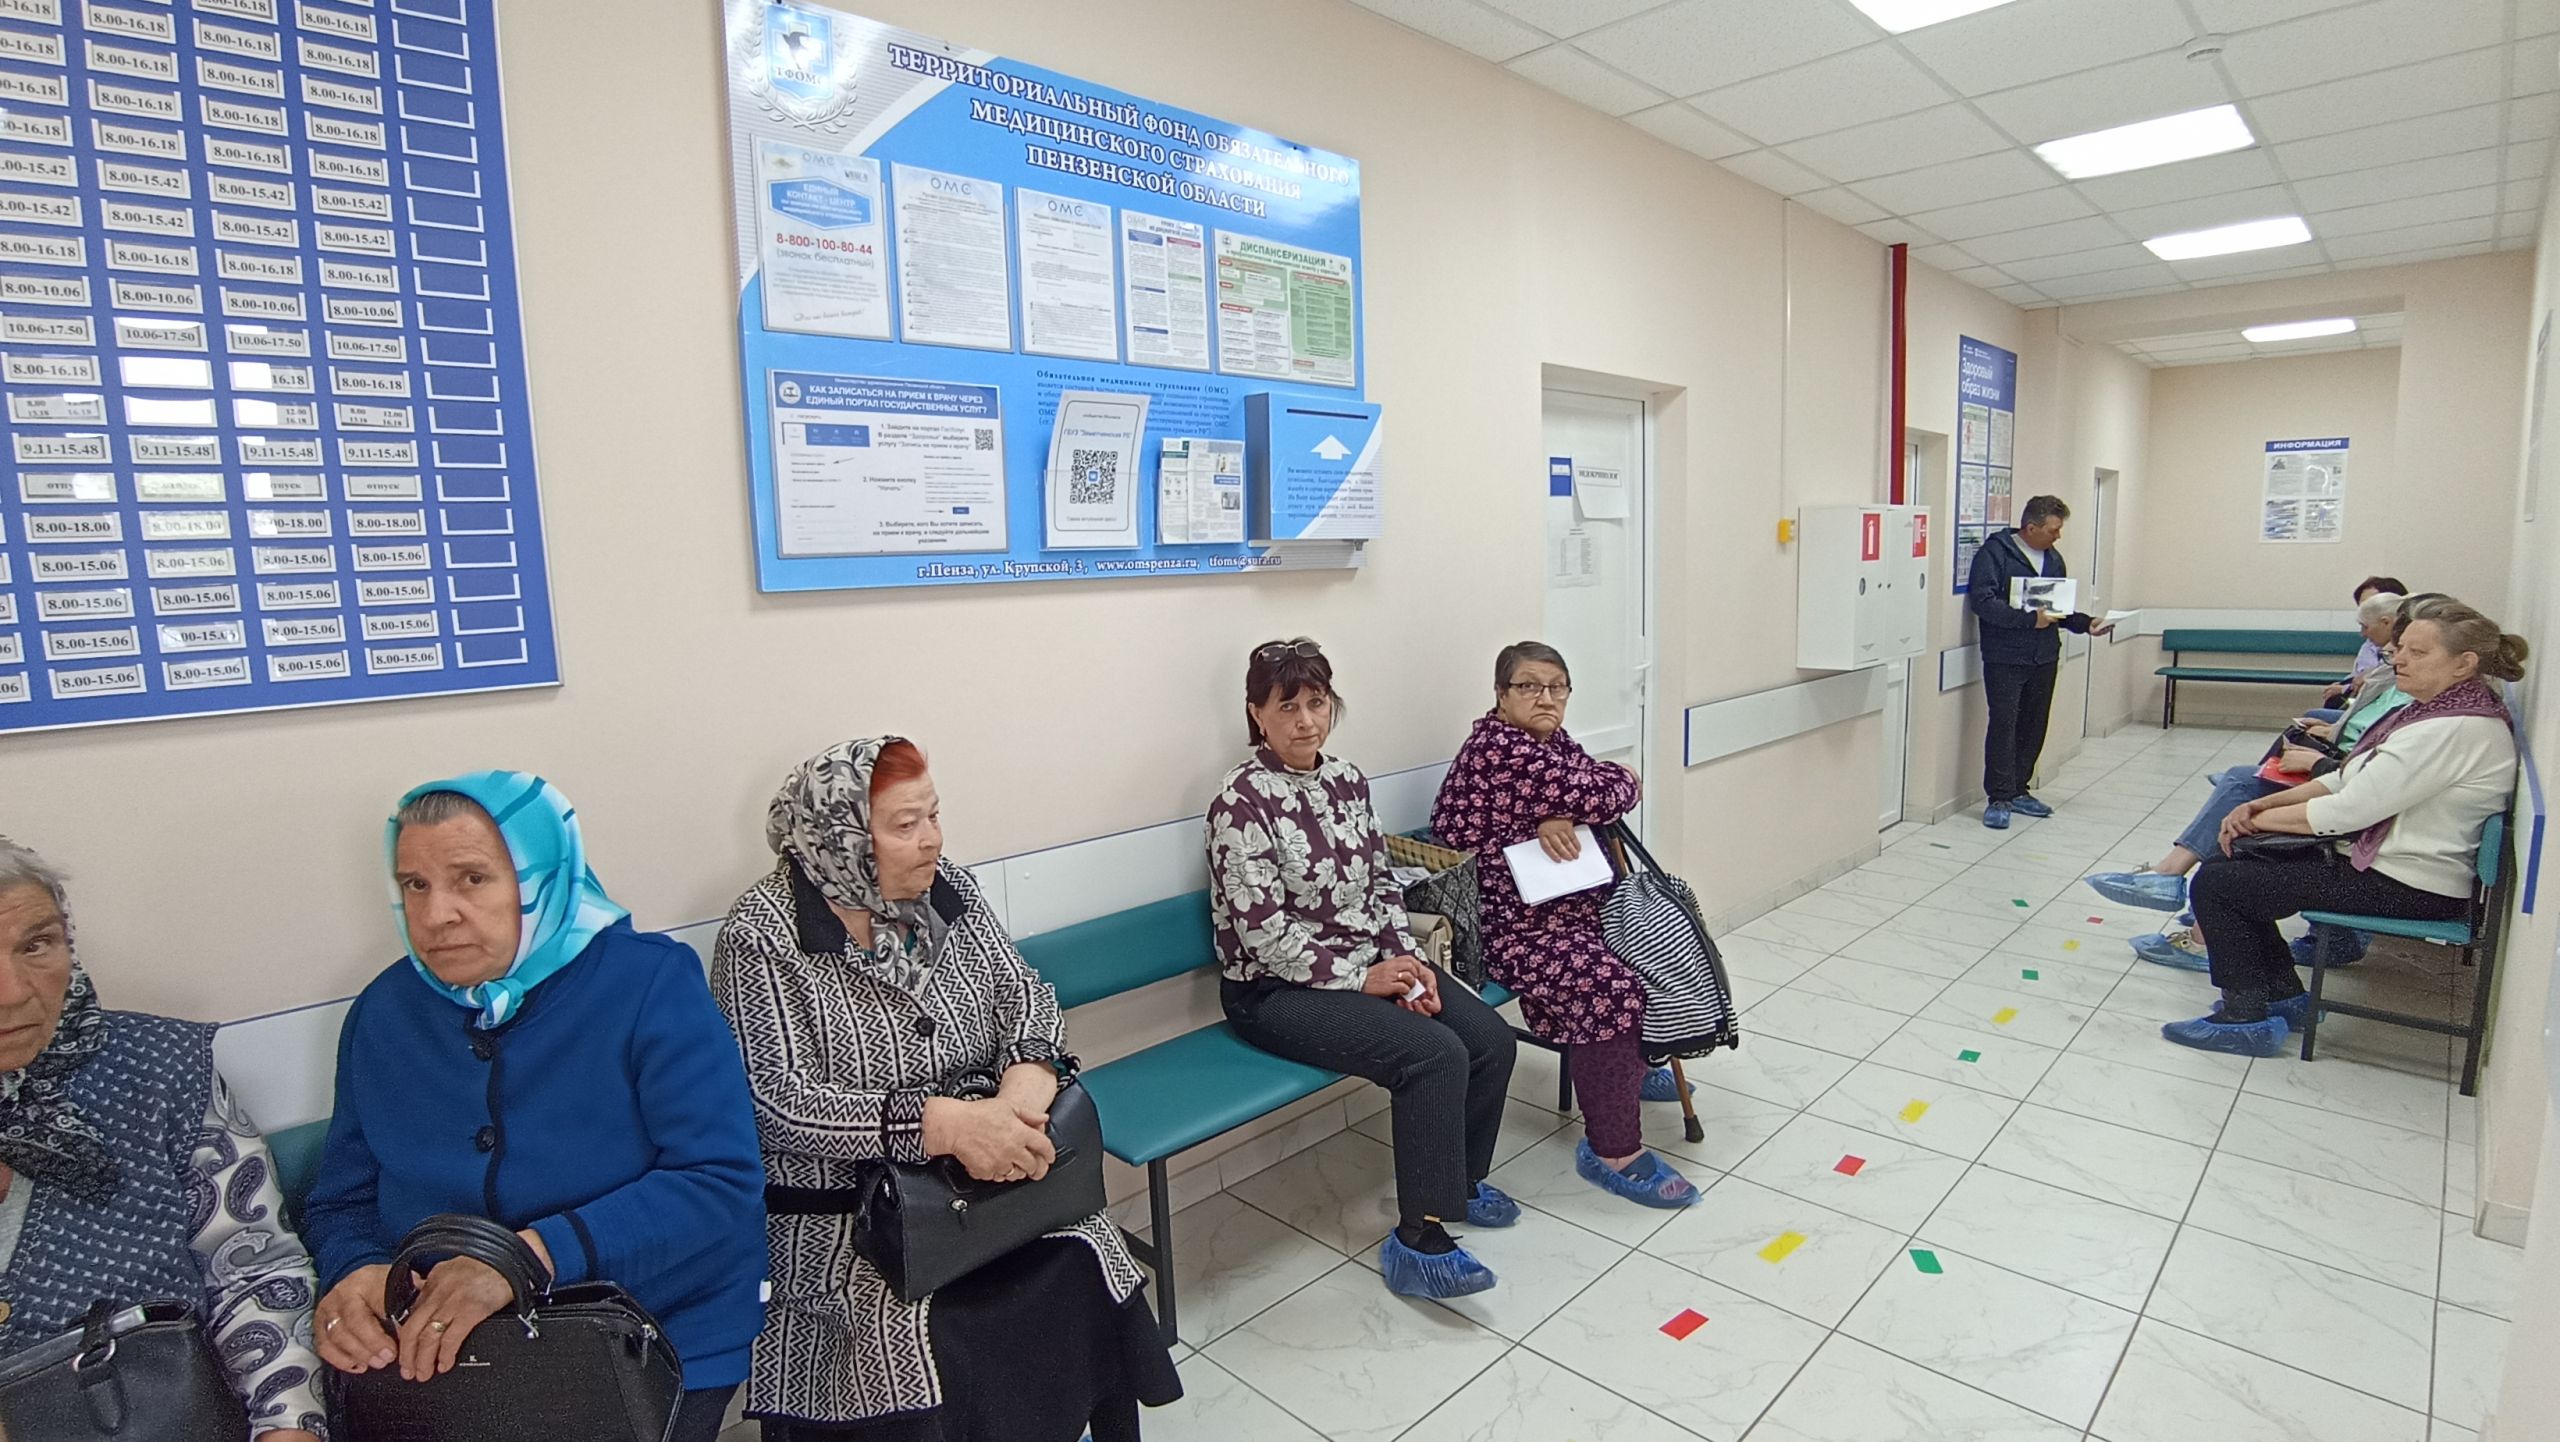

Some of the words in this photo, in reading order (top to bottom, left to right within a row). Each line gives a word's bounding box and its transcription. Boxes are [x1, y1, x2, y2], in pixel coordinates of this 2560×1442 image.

[93, 12, 166, 33] 8.00-16.18
[306, 13, 367, 33] 8.00-16.18
[203, 31, 272, 52] 8.00-16.18
[96, 52, 169, 72] 8.00-16.18
[307, 49, 370, 70] 8.00-16.18
[207, 68, 275, 89] 8.00-16.18
[101, 92, 173, 112] 8.00-16.18
[310, 86, 372, 106] 8.00-16.18
[212, 107, 279, 127] 8.00-16.18
[888, 42, 1140, 129] ТЕРРИТОРИАЛЬНЫЙ
[1143, 113, 1202, 149] ФОНД
[1204, 131, 1351, 186] ОБЯЗАТЕЛЬНОГО
[315, 122, 377, 142] 8.00-16.18
[106, 131, 177, 151] 8.00-16.18
[214, 146, 281, 165] 8.00-16.18
[970, 98, 1165, 165] МЕДИЦИНСКОГО
[1168, 149, 1303, 201] СТРАХОВАНИЯ
[318, 160, 380, 178] 8.00-16.18
[109, 170, 180, 189] 8.00-15.42
[930, 177, 972, 196] ОМС
[1026, 143, 1177, 197] ПЕНЗЕНСКОЙ
[1179, 181, 1267, 218] ОБЛАСТИ
[218, 183, 286, 201] 8.00-15.42
[803, 184, 840, 196] ЕДИНЫЙ
[321, 195, 382, 210] 8.00-15.42
[786, 190, 823, 204] КОНТАКТ
[830, 198, 856, 208] ЦЕНТР
[1048, 200, 1084, 216] ОМС
[112, 210, 184, 228] 8.00-15.42
[222, 221, 289, 238] 8.00-15.42
[324, 230, 386, 246] 8.00-15.42
[776, 233, 872, 255] 8-800-100-80-44
[0, 240, 77, 258] 8.00-16.18
[1240, 242, 1326, 267] ДИСПАНСЕРИЗАЦИЯ
[118, 250, 190, 267] 8.00-16.18
[776, 248, 812, 260] (звонок
[814, 252, 874, 269] бесплатный)
[228, 260, 294, 276] 8.00-16.18
[327, 268, 389, 284] 8.00-16.18
[5, 282, 81, 298] 8.00-10.06
[122, 290, 194, 305] 8.00-10.06
[230, 298, 296, 313] 8.00-10.06
[333, 304, 394, 318] 8.00-10.06
[8, 322, 83, 336] 10.06-17.50
[126, 328, 196, 342] 10.06-17.50
[238, 336, 301, 348] 10.06-17.50
[336, 341, 397, 354] 10.06-17.50
[12, 362, 89, 377] 8.00-16.18
[1962, 358, 1992, 380] Здоровый
[342, 378, 402, 391] 8.00-16.18
[1036, 370, 1095, 382] Обязательное
[1100, 377, 1151, 388] медицинское
[1204, 386, 1230, 395] (ОМС)
[1962, 378, 1980, 399] образ
[1982, 386, 2000, 400] жизни
[810, 385, 826, 394] КАК
[828, 386, 883, 398] ЗАПИСАТЬСЯ
[884, 390, 898, 398] НА
[898, 391, 926, 400] ПРИЕМ
[934, 394, 958, 403] ВРАЧУ
[958, 395, 984, 404] ЧЕРЕЗ
[806, 396, 844, 406] ЕДИНЫЙ
[846, 399, 878, 408] ПОРТАЛ
[880, 400, 959, 414] ГОСУДАРСТВЕННЫХ
[960, 404, 988, 415] УСЛУГ?
[24, 444, 100, 456] 9.11-15.48
[140, 444, 211, 457] 9.11-15.48
[250, 448, 314, 458] 9.11-15.48
[2273, 440, 2342, 450] ИНФОРМАЦИЯ
[348, 448, 409, 459] 9.11-15.48
[366, 482, 400, 491] отпуск
[36, 522, 111, 534] 8.00-18.00
[356, 518, 417, 529] 8.00-18.00
[362, 552, 422, 562] 8.00-15.06
[42, 560, 117, 573] 8.00-15.06
[917, 561, 978, 578] г.Пенза,
[981, 562, 1001, 578] ул.
[1003, 560, 1073, 578] Крупской,
[1074, 560, 1088, 574] 3,
[1096, 558, 1200, 572] www.omspenza.ru,
[1209, 554, 1282, 568] tfoms@sura.ru
[163, 592, 230, 606] 8.00-15.06
[267, 590, 331, 601] 8.00-15.06
[365, 586, 425, 598] 8.00-15.06
[48, 598, 122, 610] 8.00-15.06
[370, 620, 430, 631] 8.00-15.06
[56, 635, 129, 650] 8.00-15.06
[278, 659, 341, 673] 8.00-15.06
[376, 653, 434, 666] 8.00-15.06
[174, 664, 240, 680] 8.00-15.06
[62, 674, 136, 688] 8.00-15.06
